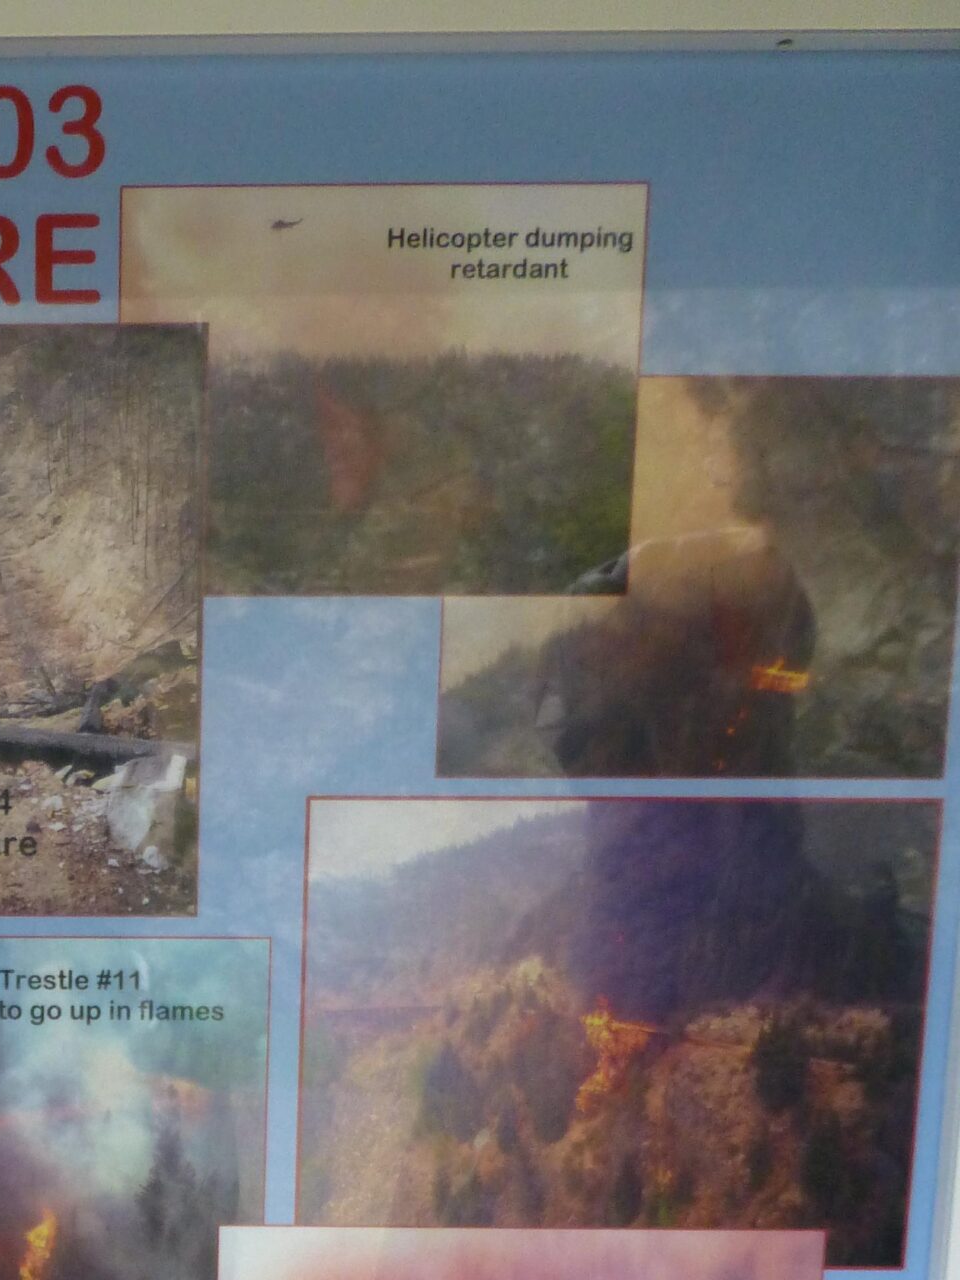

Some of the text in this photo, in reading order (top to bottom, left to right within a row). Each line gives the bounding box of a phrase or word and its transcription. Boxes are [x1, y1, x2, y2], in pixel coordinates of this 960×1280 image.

[387, 226, 634, 253] Helicopter dumping
[450, 257, 570, 279] retardant
[96, 969, 141, 991] #11
[29, 1004, 62, 1026] go
[69, 1004, 101, 1027] up
[109, 999, 131, 1020] in
[140, 999, 225, 1021] flames
